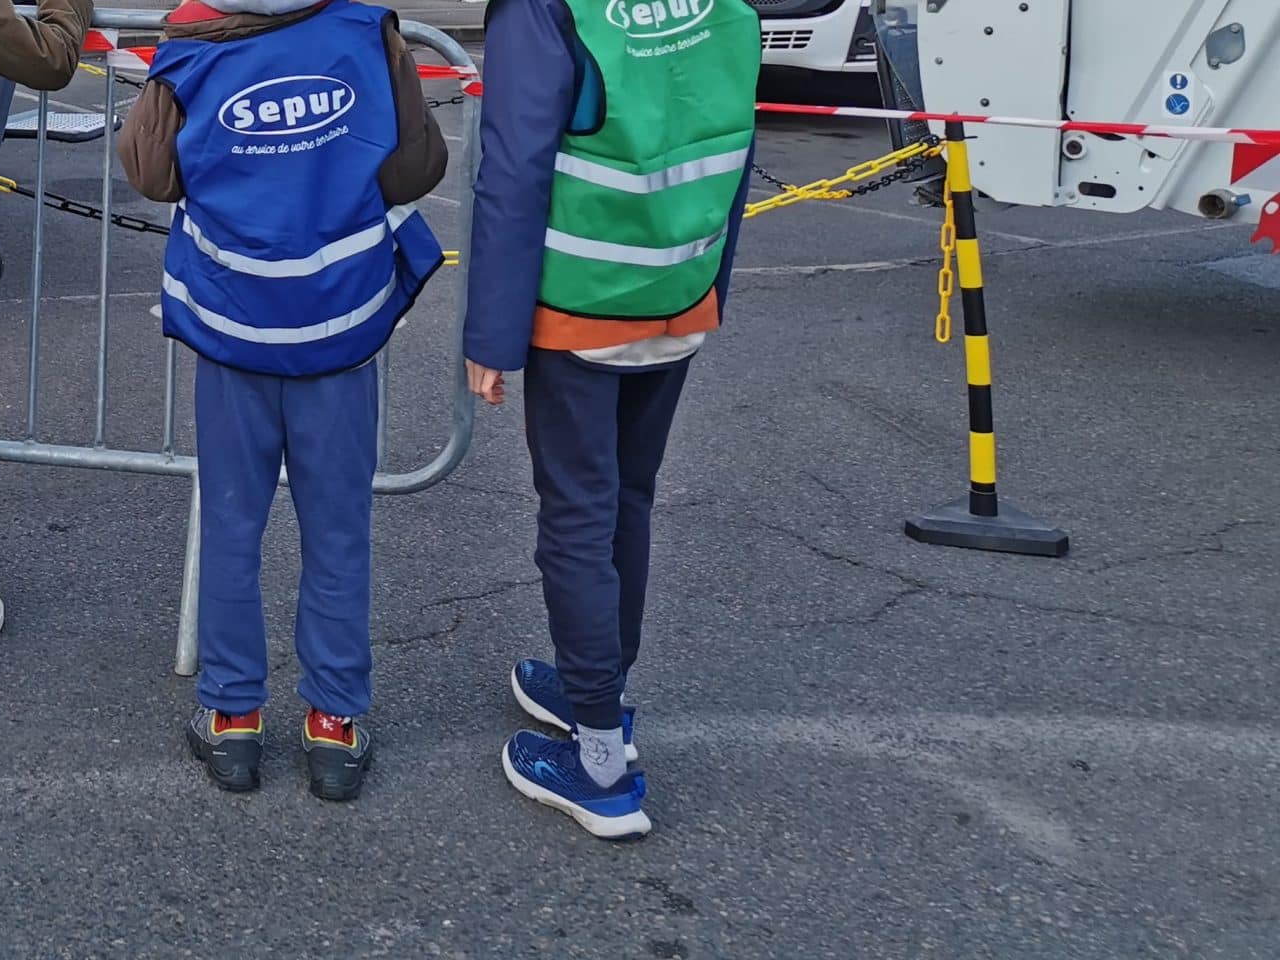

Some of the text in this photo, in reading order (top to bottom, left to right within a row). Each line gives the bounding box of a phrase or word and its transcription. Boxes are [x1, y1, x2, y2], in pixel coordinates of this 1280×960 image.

[232, 88, 346, 129] Sepur
[231, 145, 244, 154] au
[245, 144, 276, 154] service
[277, 143, 289, 154] de
[291, 139, 315, 152] votre
